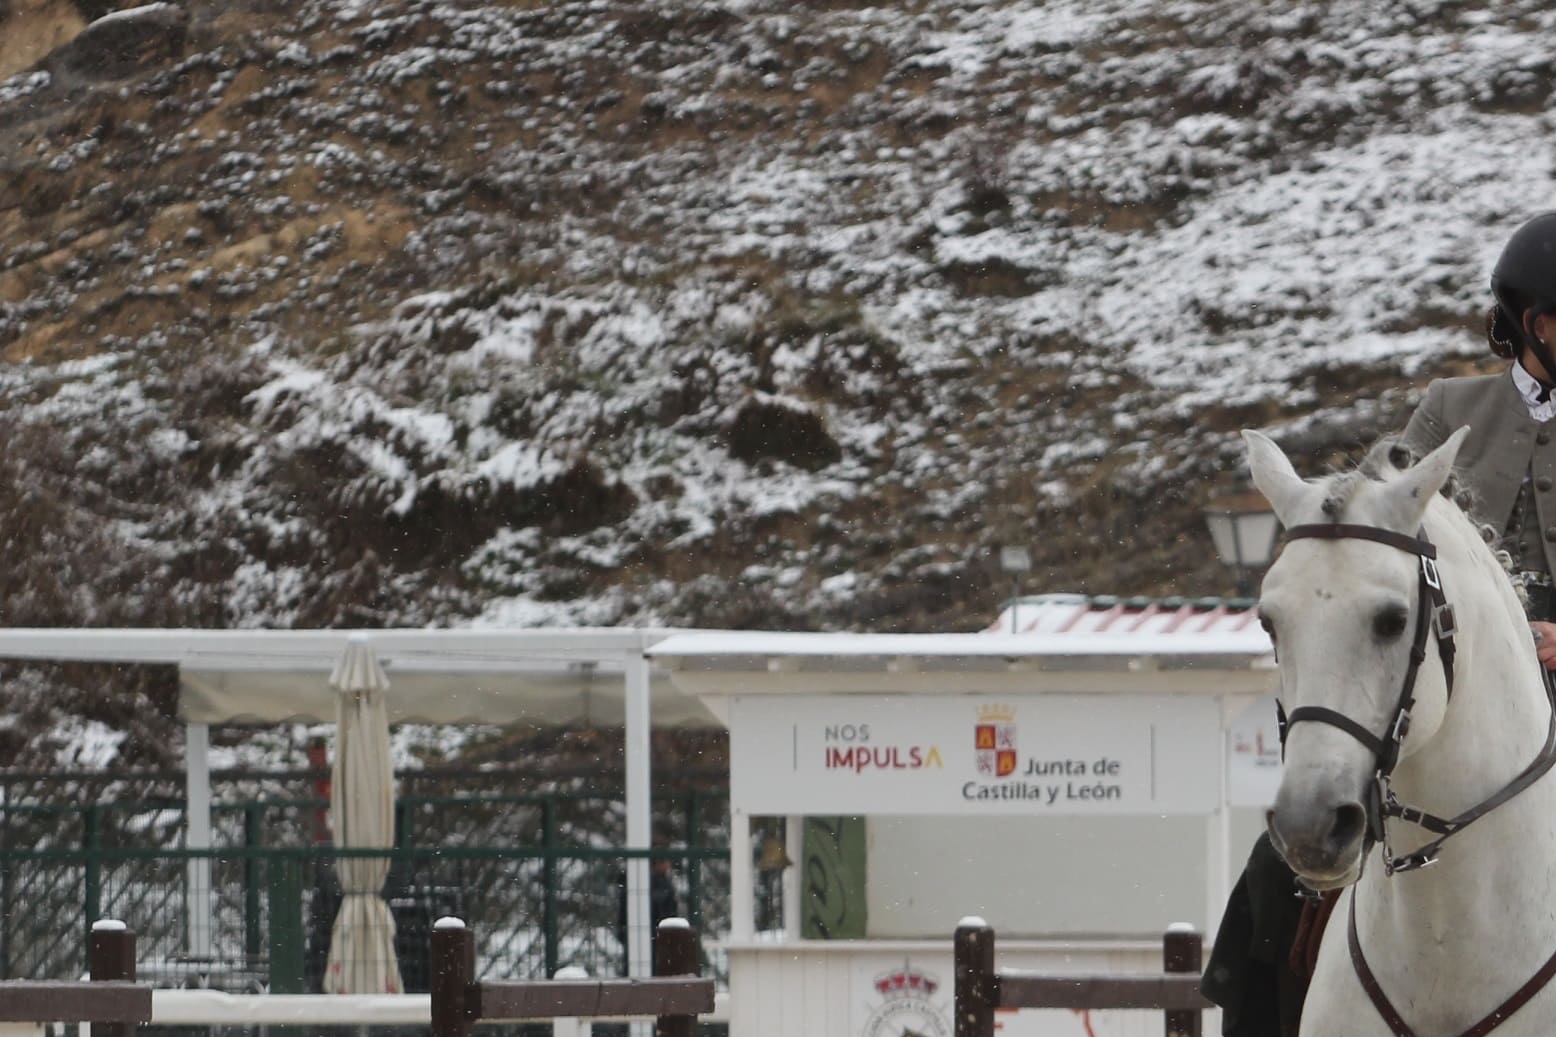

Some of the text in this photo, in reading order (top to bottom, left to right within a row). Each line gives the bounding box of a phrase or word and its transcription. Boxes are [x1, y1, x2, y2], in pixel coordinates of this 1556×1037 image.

[825, 725, 870, 741] NOS
[825, 746, 943, 773] IMPULSA
[1023, 756, 1120, 776] Junta de
[962, 781, 1121, 804] Castilla y León
